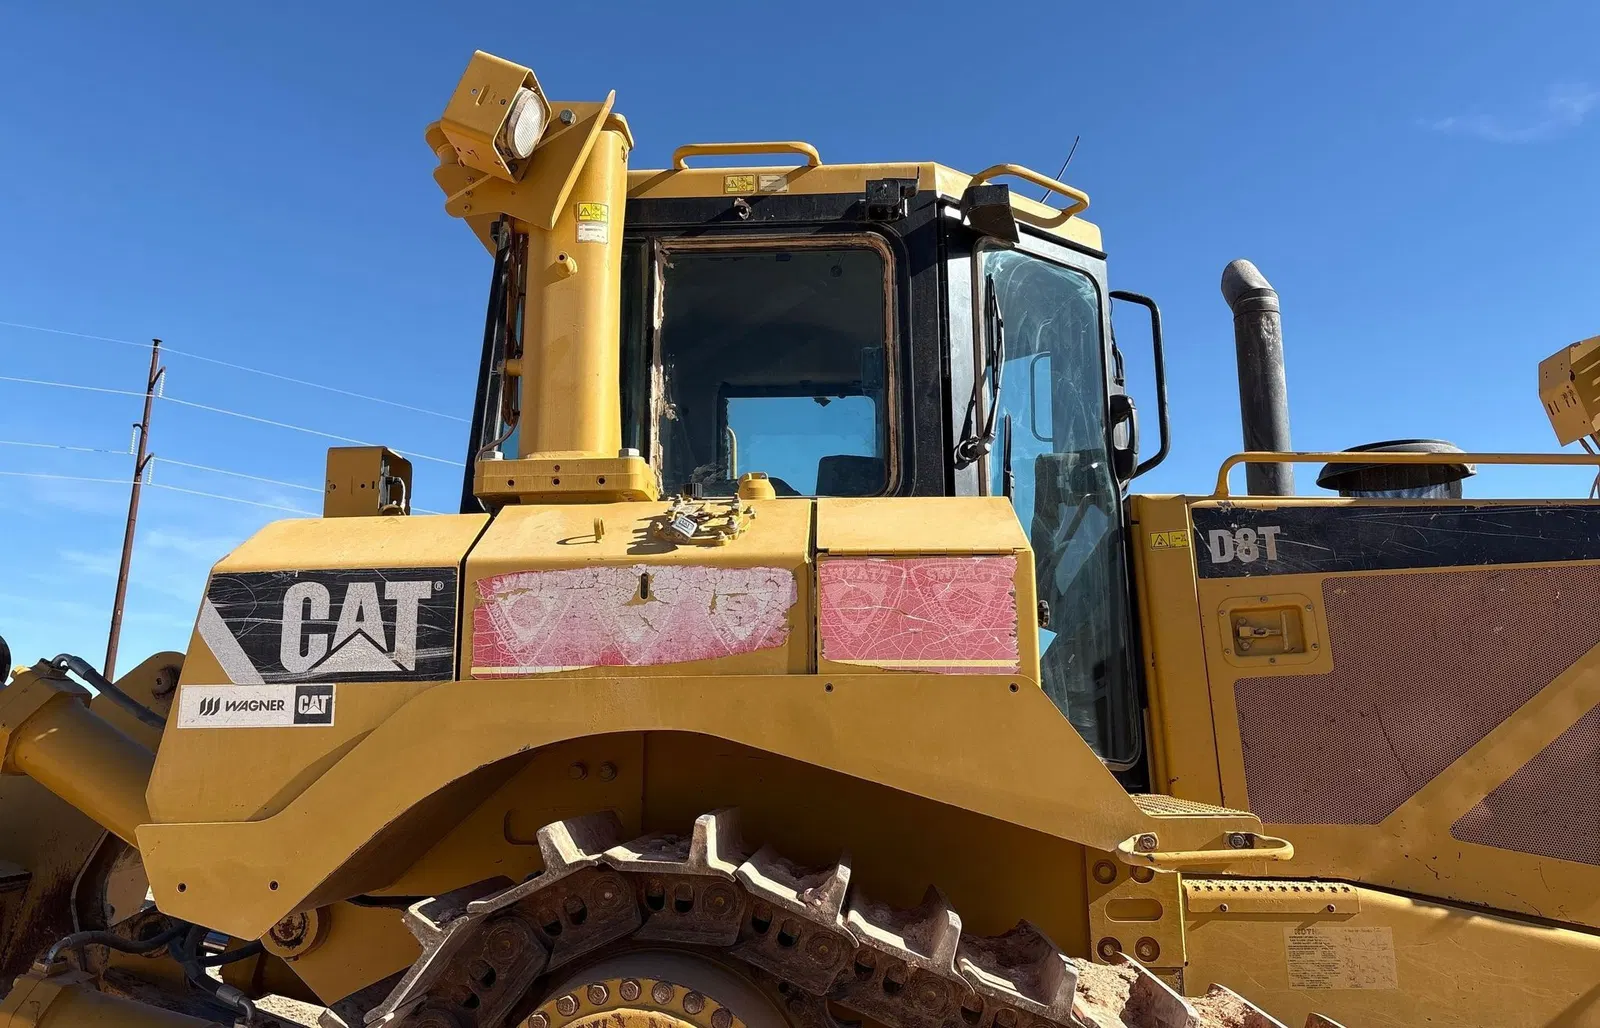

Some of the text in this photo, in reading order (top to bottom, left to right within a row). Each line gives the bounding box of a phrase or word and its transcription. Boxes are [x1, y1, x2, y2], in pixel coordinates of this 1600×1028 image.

[1208, 525, 1281, 563] D8T
[225, 694, 330, 715] WAGNER CAT
